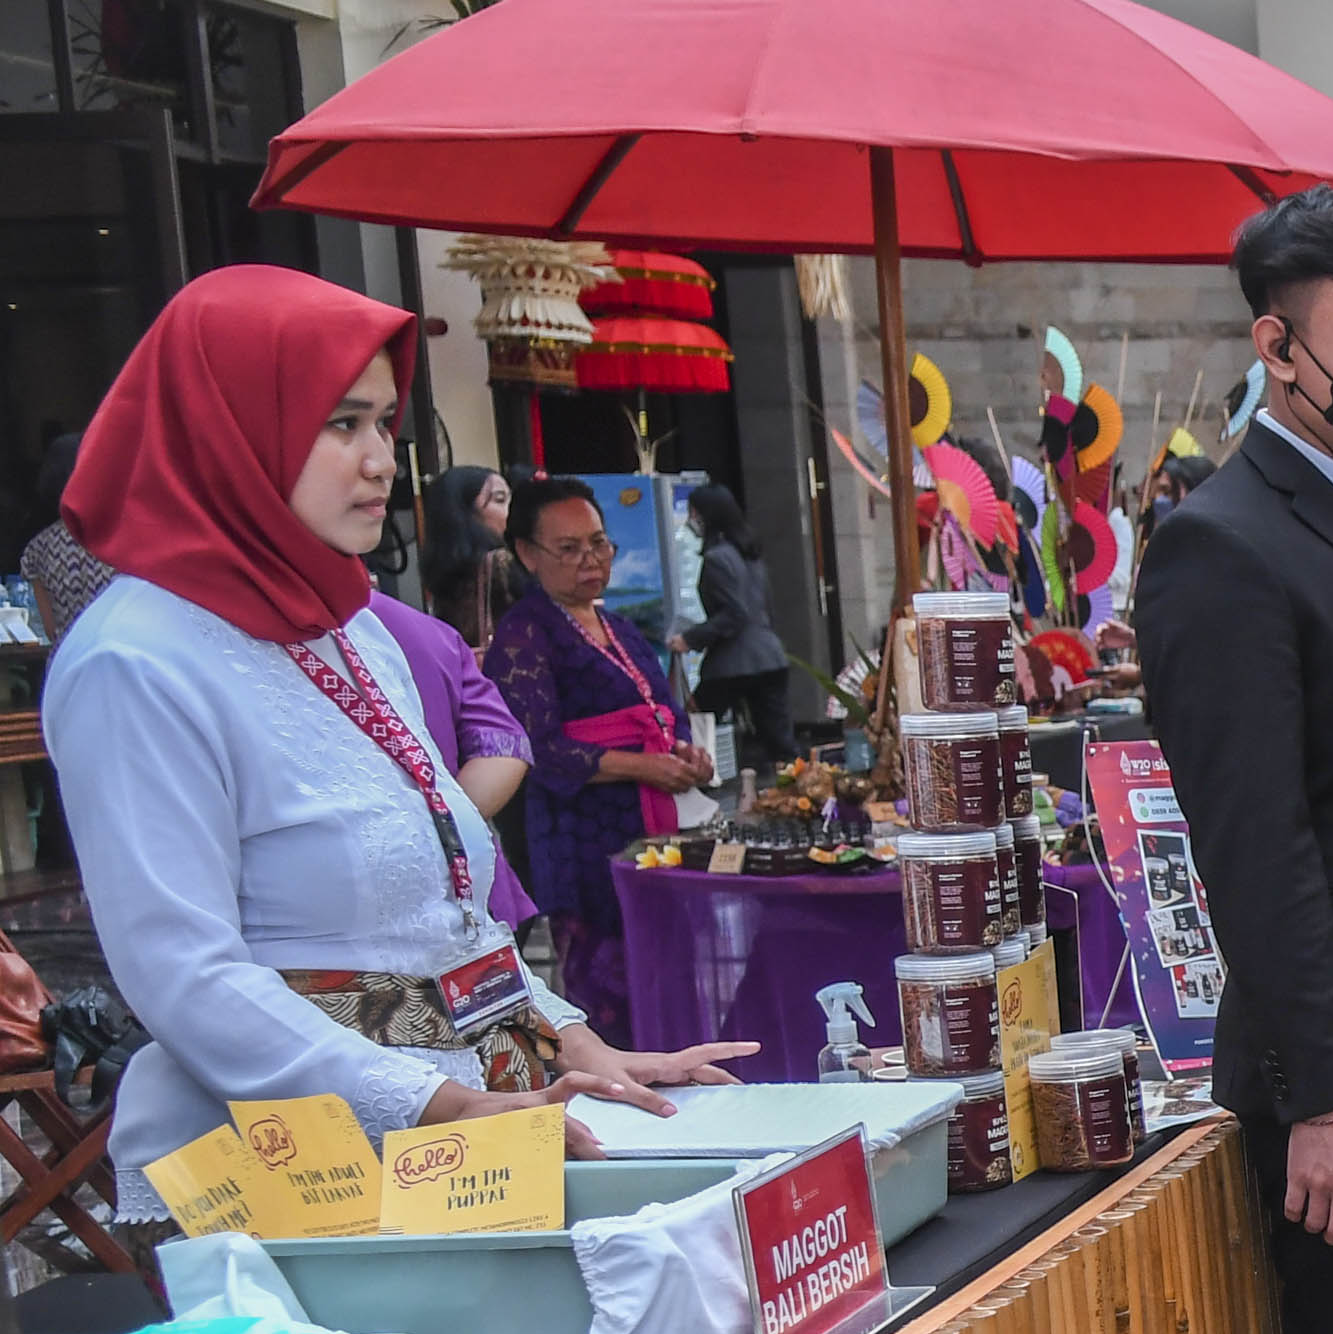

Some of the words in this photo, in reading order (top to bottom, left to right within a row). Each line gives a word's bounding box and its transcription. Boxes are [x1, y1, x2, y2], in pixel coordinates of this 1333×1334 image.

[253, 1127, 291, 1158] hello
[329, 1161, 366, 1182] ADULT
[393, 1147, 458, 1177] hello
[210, 1175, 244, 1206] DARE
[323, 1182, 364, 1204] LARVAE
[450, 1175, 476, 1192] I'M
[483, 1166, 513, 1186] THE
[447, 1186, 510, 1210] PUPPAE
[772, 1204, 848, 1284] MAGGOT
[806, 1240, 870, 1311] BERSIH
